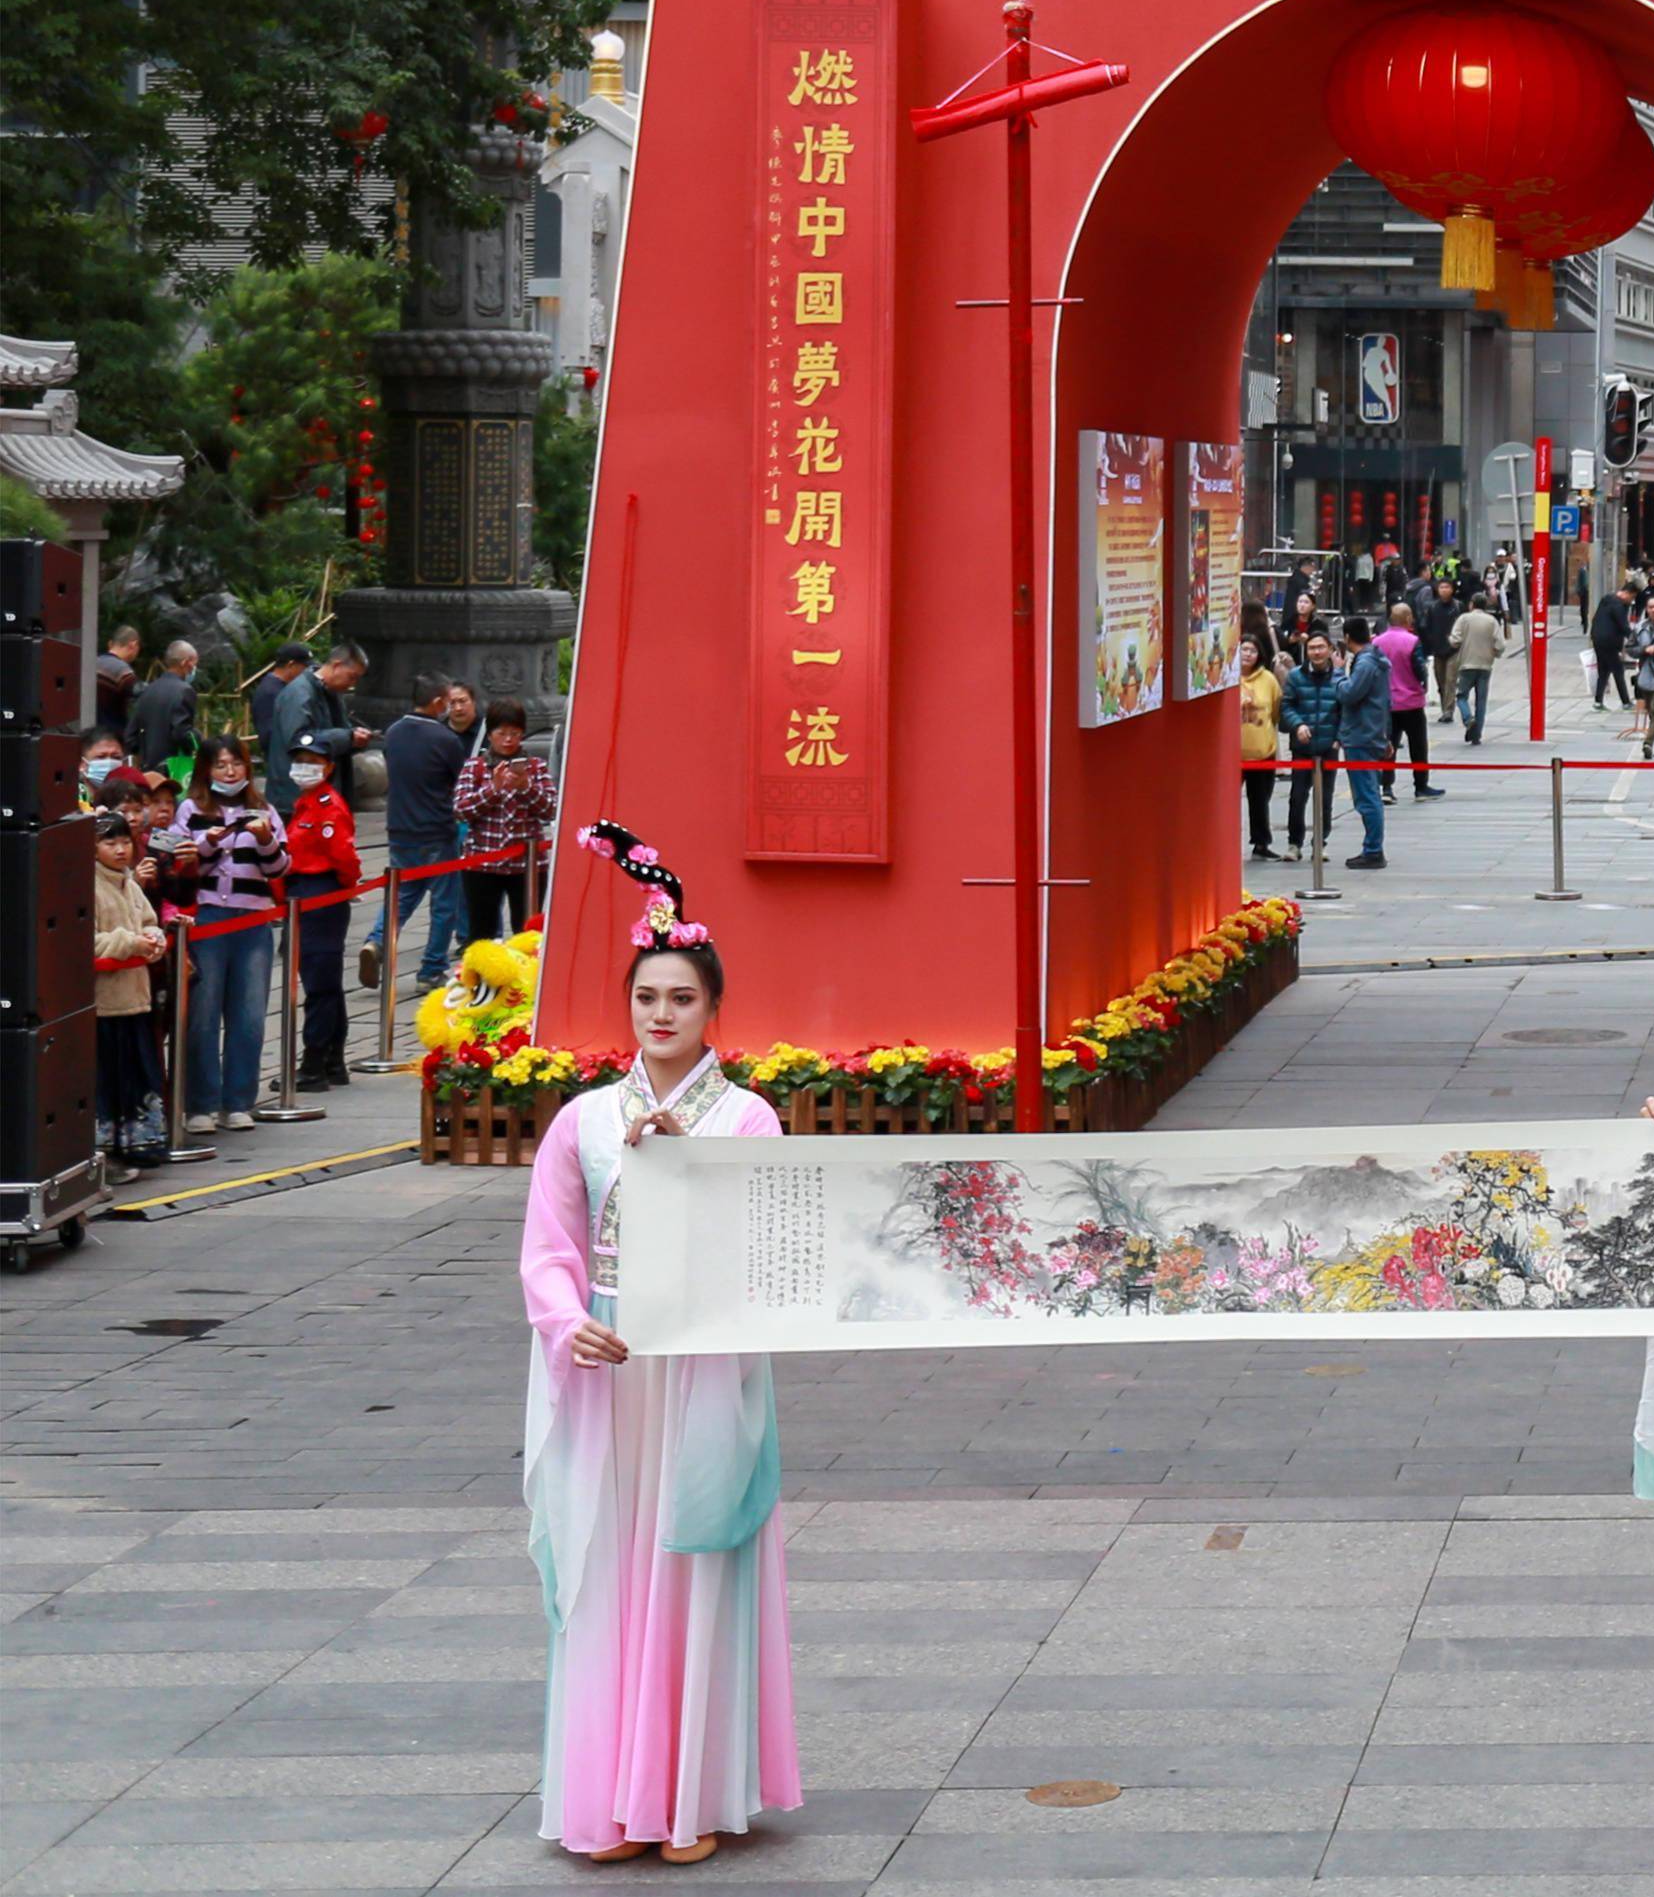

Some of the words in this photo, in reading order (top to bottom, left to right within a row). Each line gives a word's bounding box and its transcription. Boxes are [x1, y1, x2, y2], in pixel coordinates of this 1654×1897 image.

[783, 48, 860, 769] 燃情中國夢花開第一流
[1365, 402, 1386, 418] NBA
[1557, 511, 1573, 532] P
